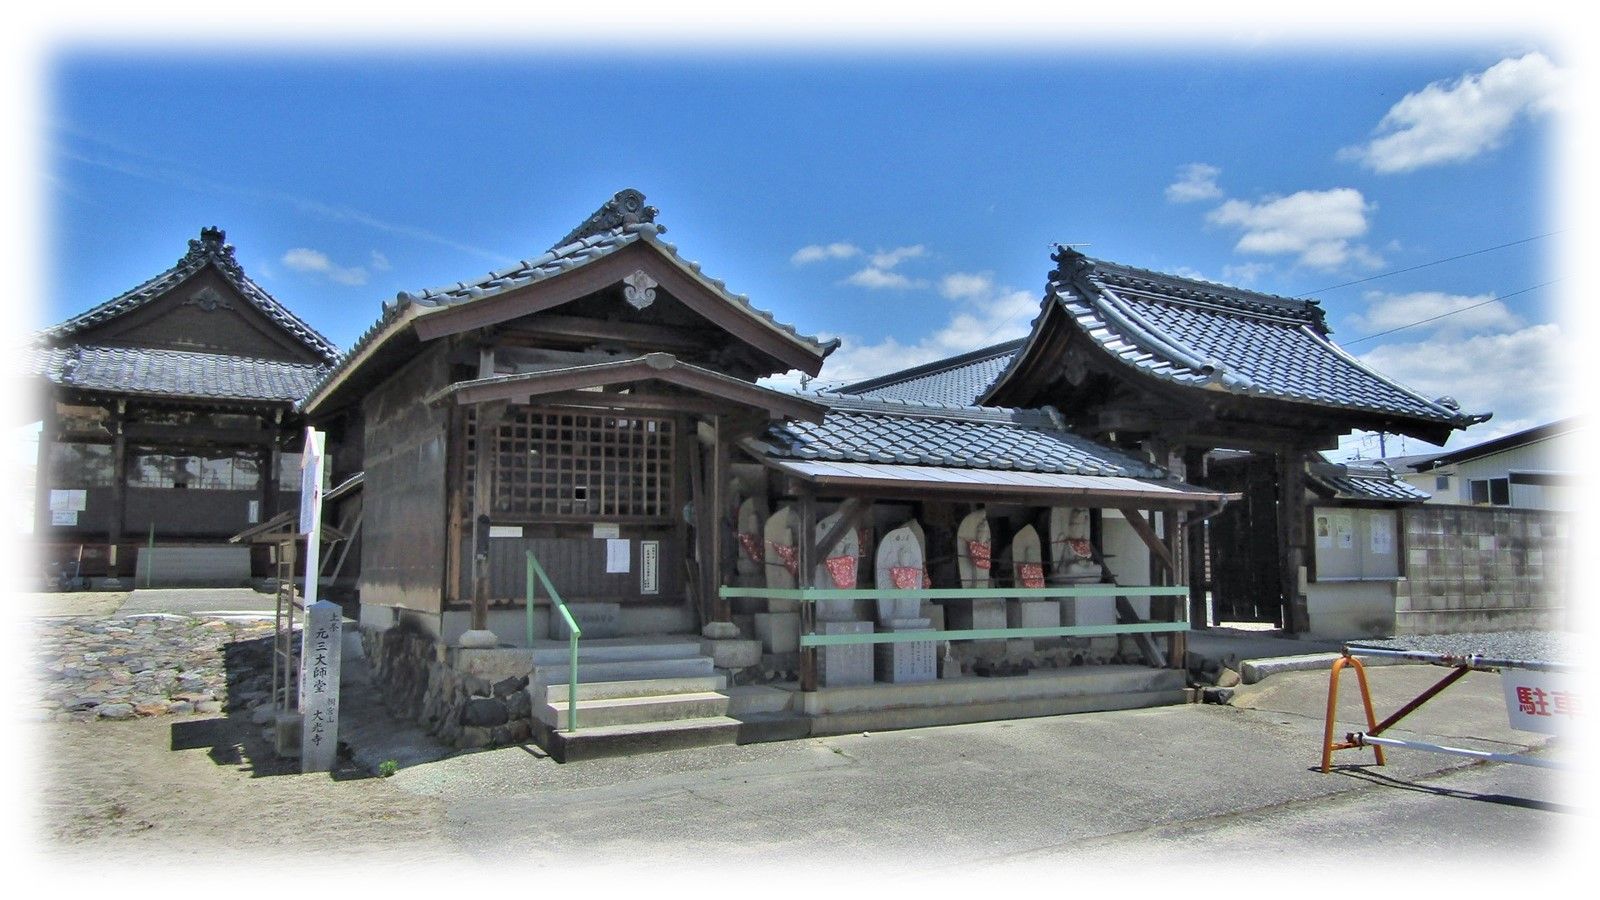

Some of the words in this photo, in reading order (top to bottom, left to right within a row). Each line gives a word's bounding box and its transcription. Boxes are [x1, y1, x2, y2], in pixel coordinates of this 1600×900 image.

[313, 627, 329, 694] 元三大師堂
[311, 709, 324, 746] 大光寺
